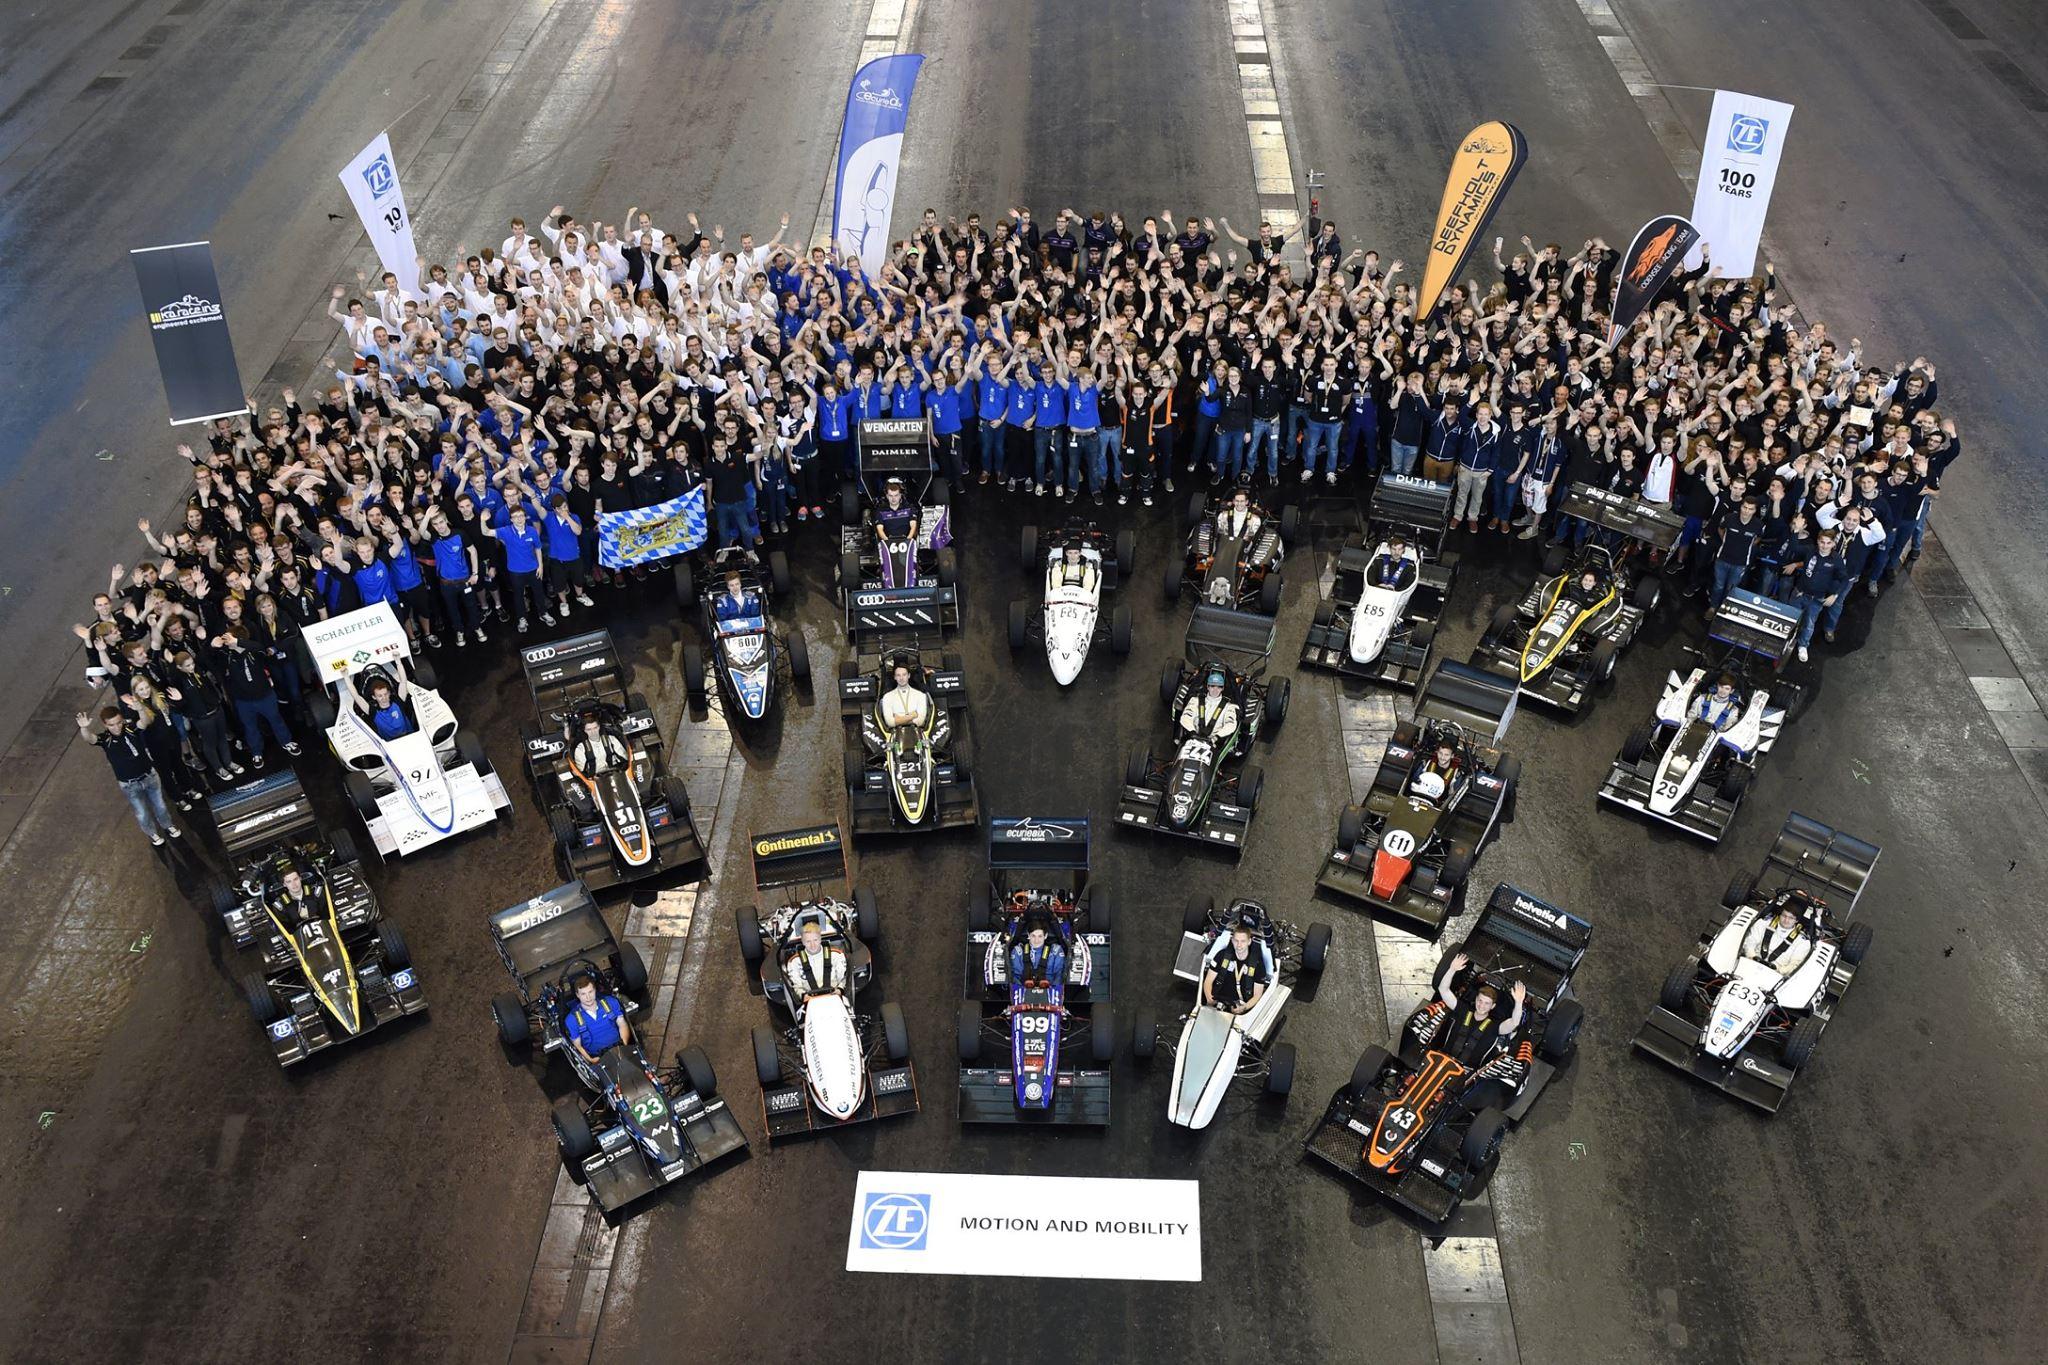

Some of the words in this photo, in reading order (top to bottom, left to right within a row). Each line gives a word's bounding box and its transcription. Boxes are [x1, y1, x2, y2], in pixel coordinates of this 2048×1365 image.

[1732, 120, 1764, 149] ZF
[368, 160, 393, 193] ZF
[1720, 168, 1755, 188] 100
[1718, 184, 1752, 199] YEARS
[1443, 170, 1496, 256] DYNAMICS
[153, 320, 188, 330] engineered
[189, 314, 223, 325] excitement
[863, 421, 923, 433] WEINGARTEN
[1586, 487, 1605, 500] plug
[1605, 494, 1624, 504] and
[889, 542, 908, 554] 60
[862, 582, 882, 590] ETAS
[918, 578, 937, 588] ETAS
[1364, 604, 1385, 617] E85
[315, 615, 383, 643] SCHAEFFLER
[1762, 618, 1792, 634] ETAS
[375, 643, 399, 655] FAG
[900, 762, 921, 772] E21
[1655, 781, 1679, 800] 29
[614, 807, 636, 826] 31
[756, 832, 825, 856] Continental
[1388, 835, 1411, 853] E11
[521, 905, 562, 931] DENSO
[1515, 896, 1556, 923] helvetia
[302, 920, 324, 938] 15
[973, 934, 992, 943] 100
[1086, 935, 1106, 945] 100
[1728, 983, 1760, 1006] E33
[1022, 1016, 1049, 1034] 99
[1024, 1043, 1046, 1051] ETAS
[809, 1036, 824, 1082] DRESDEN
[879, 1073, 906, 1087] NWK
[674, 1094, 699, 1109] AIRBUS
[771, 1091, 798, 1106] NWK
[634, 1097, 664, 1121] 23
[1390, 1107, 1416, 1130] 43
[600, 1128, 626, 1145] AIRBUS
[867, 1197, 925, 1244] ZF
[960, 1217, 1039, 1231] MOTION
[1046, 1219, 1088, 1233] AND
[1095, 1221, 1189, 1236] MOBILITY
